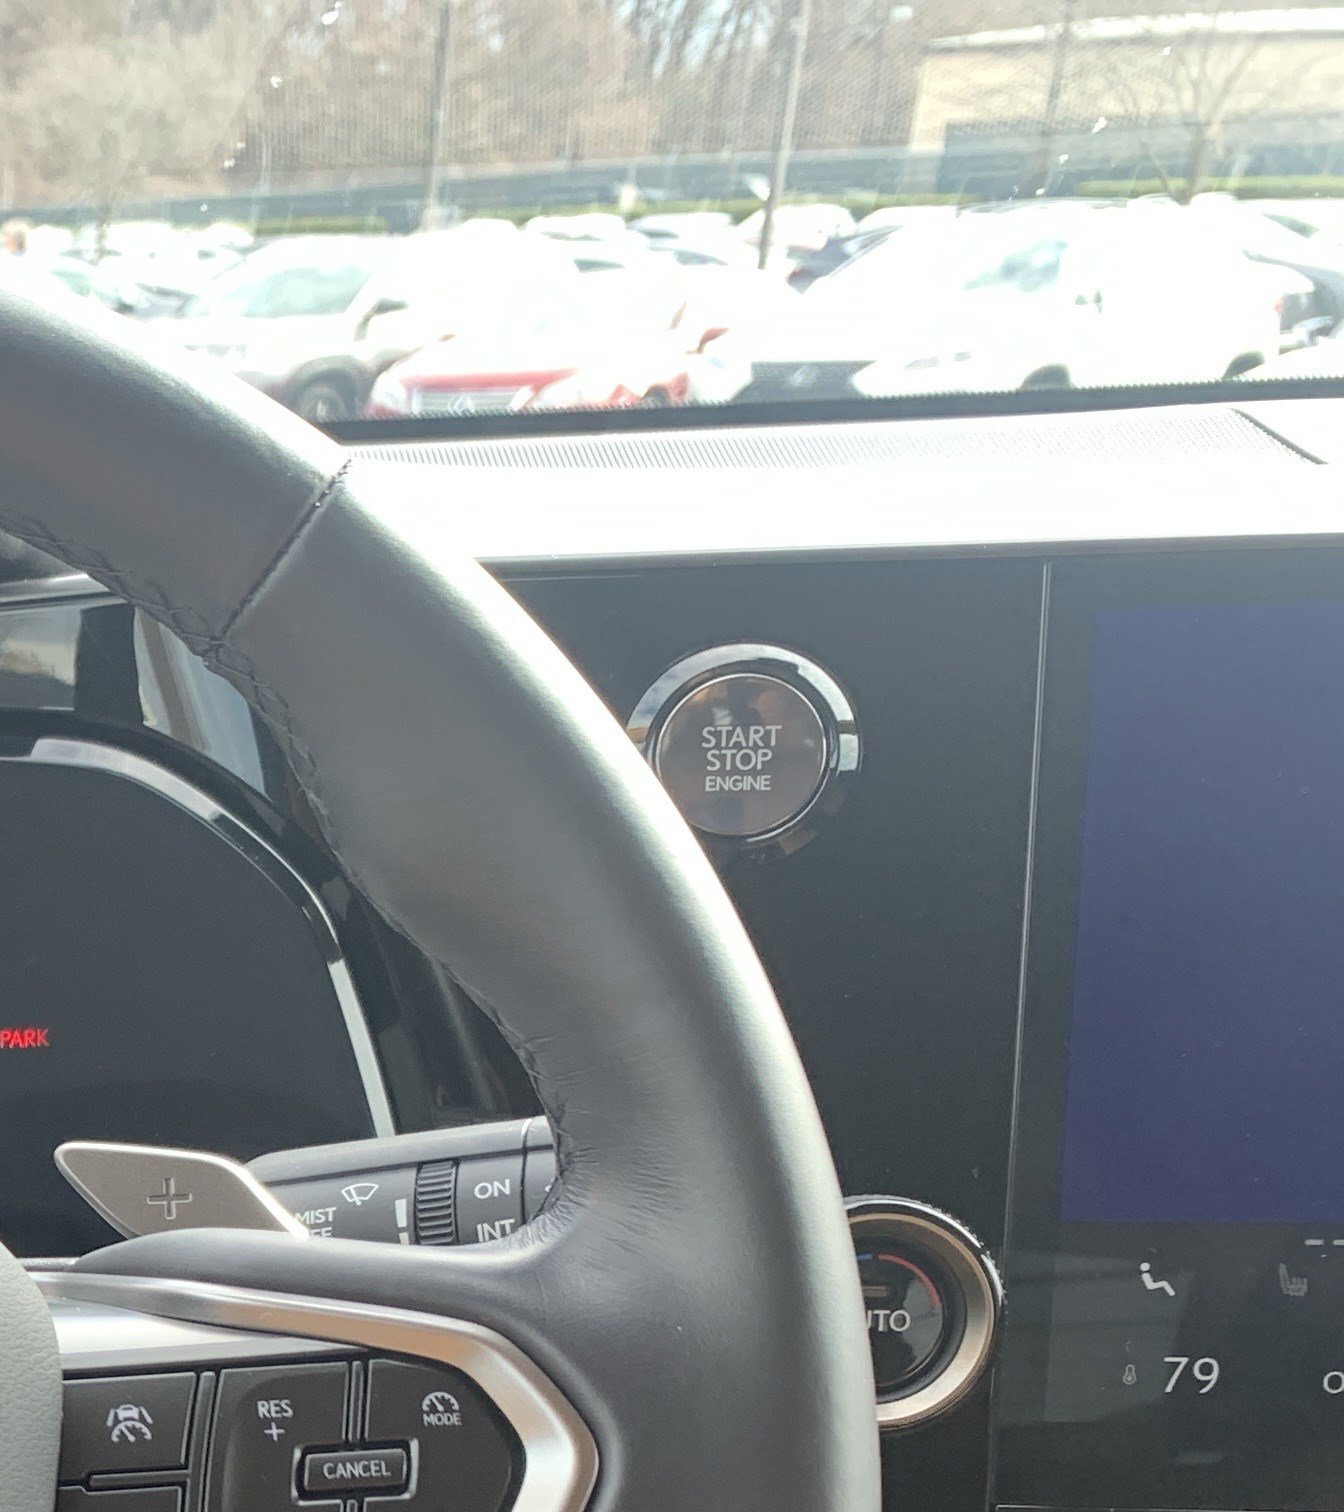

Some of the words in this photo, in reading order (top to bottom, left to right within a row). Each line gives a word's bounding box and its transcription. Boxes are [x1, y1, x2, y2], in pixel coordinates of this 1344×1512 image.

[701, 725, 782, 748] START
[706, 749, 773, 771] STOP
[705, 774, 772, 792] ENGINE
[474, 1179, 510, 1199] ON
[295, 1206, 337, 1224] MIST
[476, 1218, 515, 1243] INT
[867, 1310, 911, 1332] TO
[1163, 1356, 1220, 1394] 79
[257, 1399, 293, 1419] RES
[422, 1413, 462, 1427] MODE
[322, 1460, 391, 1480] CANCEL
